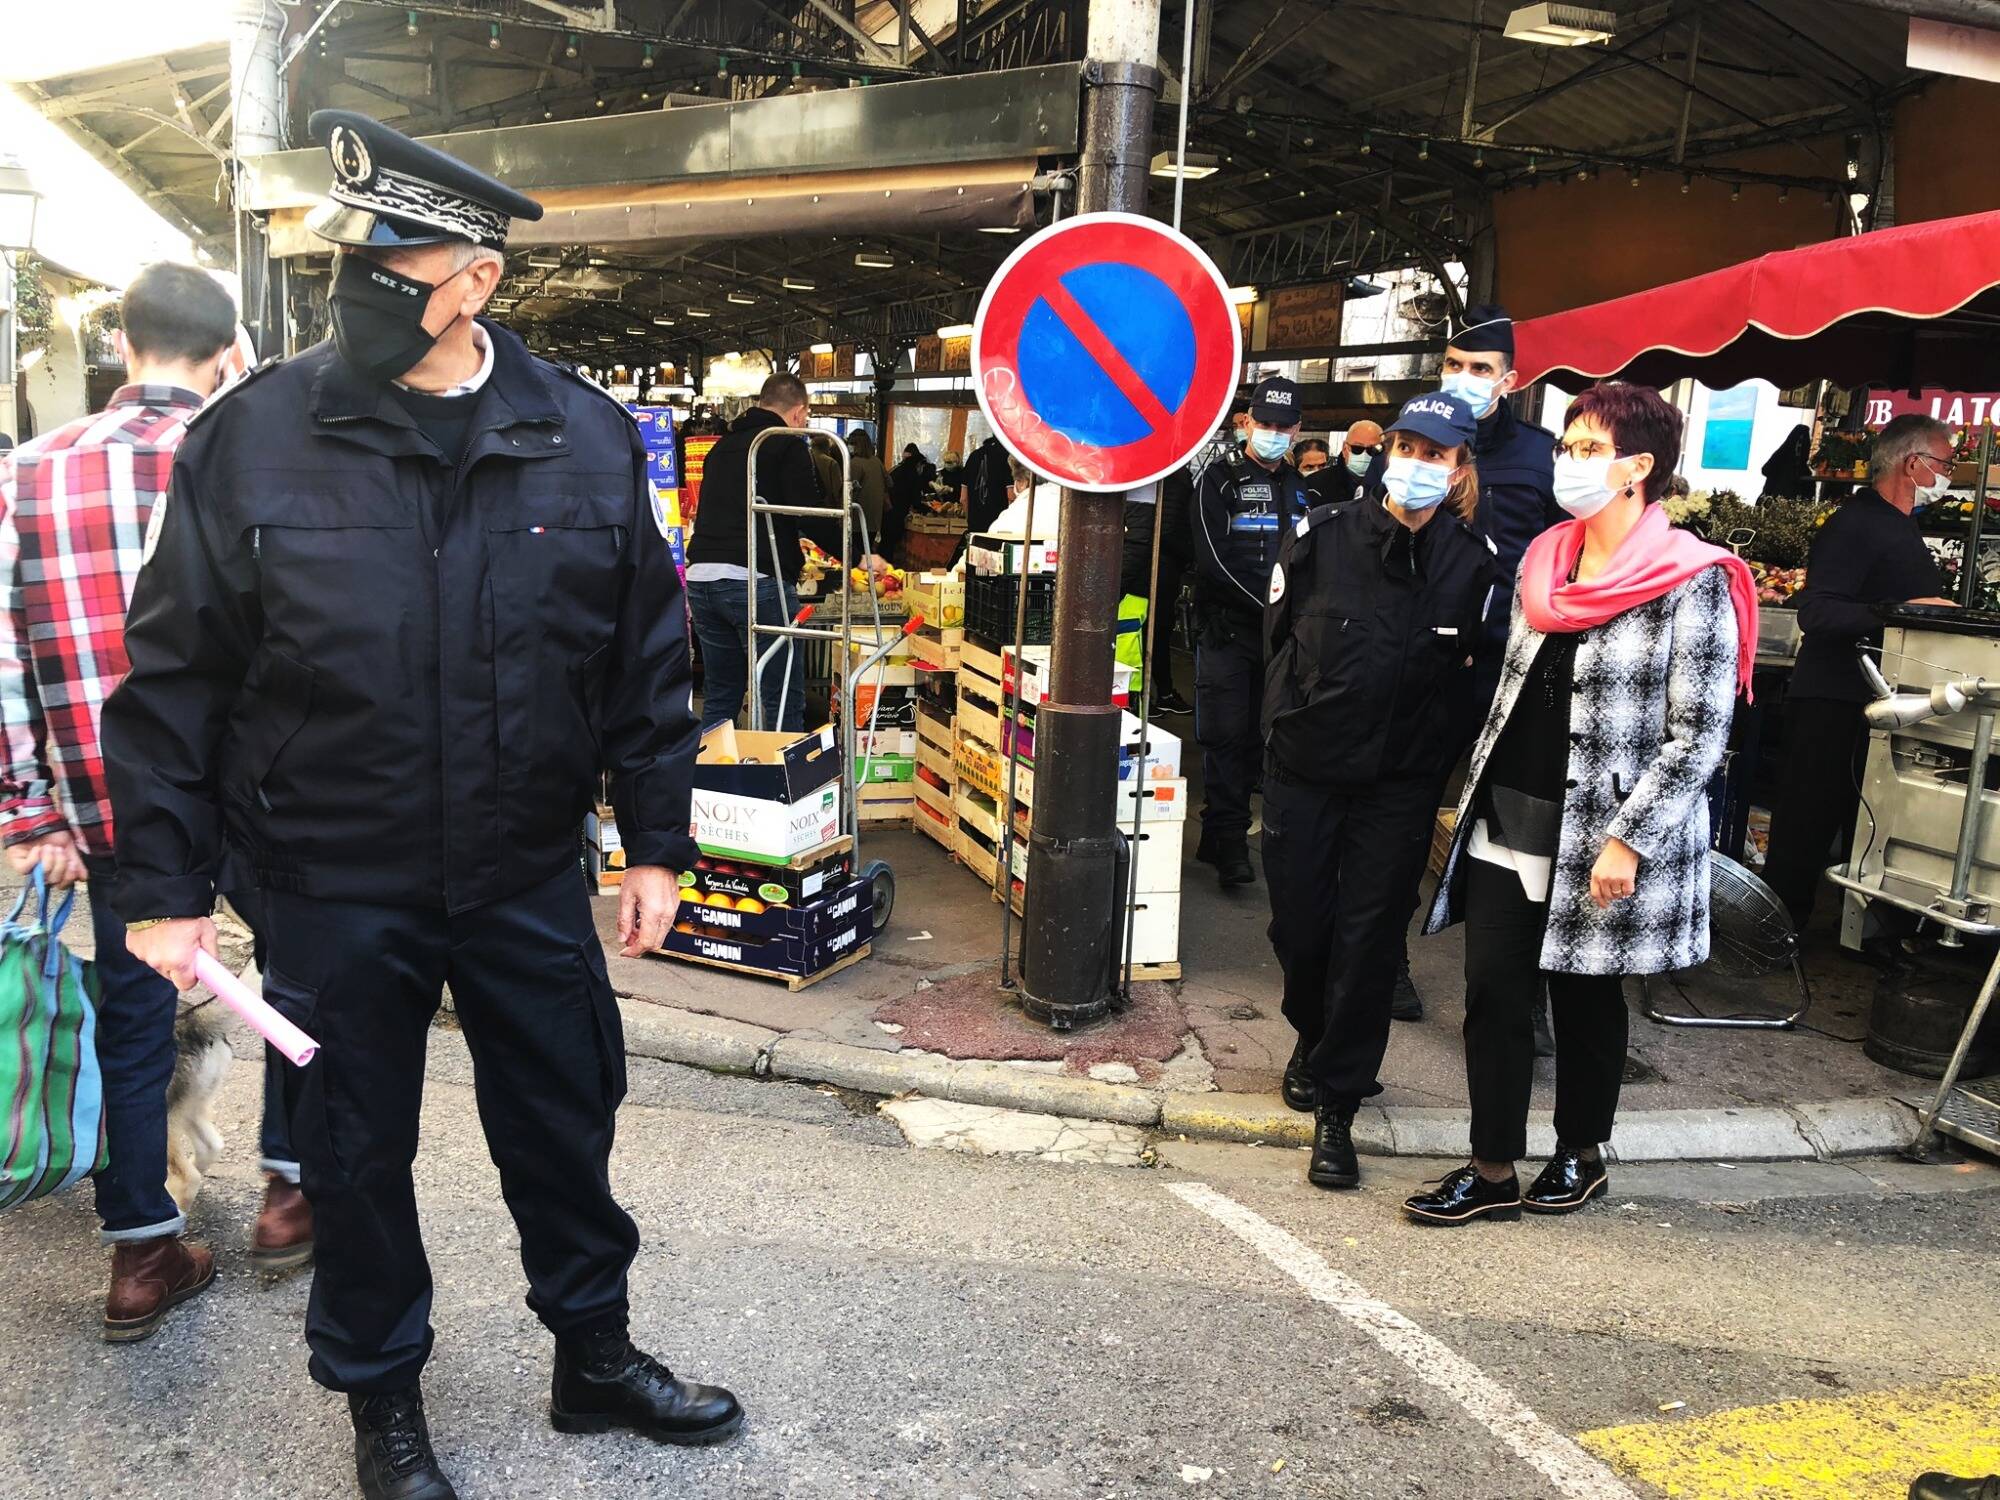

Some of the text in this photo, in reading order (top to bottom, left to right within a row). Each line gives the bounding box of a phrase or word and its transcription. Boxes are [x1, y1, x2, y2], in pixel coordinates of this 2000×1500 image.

[371, 271, 419, 296] CSI 75
[1266, 390, 1292, 400] POLICE
[1404, 399, 1454, 420] POLICE
[700, 822, 749, 842] SÈCHES
[789, 811, 819, 834] NOIX
[827, 893, 857, 919] LE GAMIN
[702, 911, 741, 927] GAMIN
[827, 926, 856, 952] LE GAMIN
[702, 943, 742, 961] GAMIN
